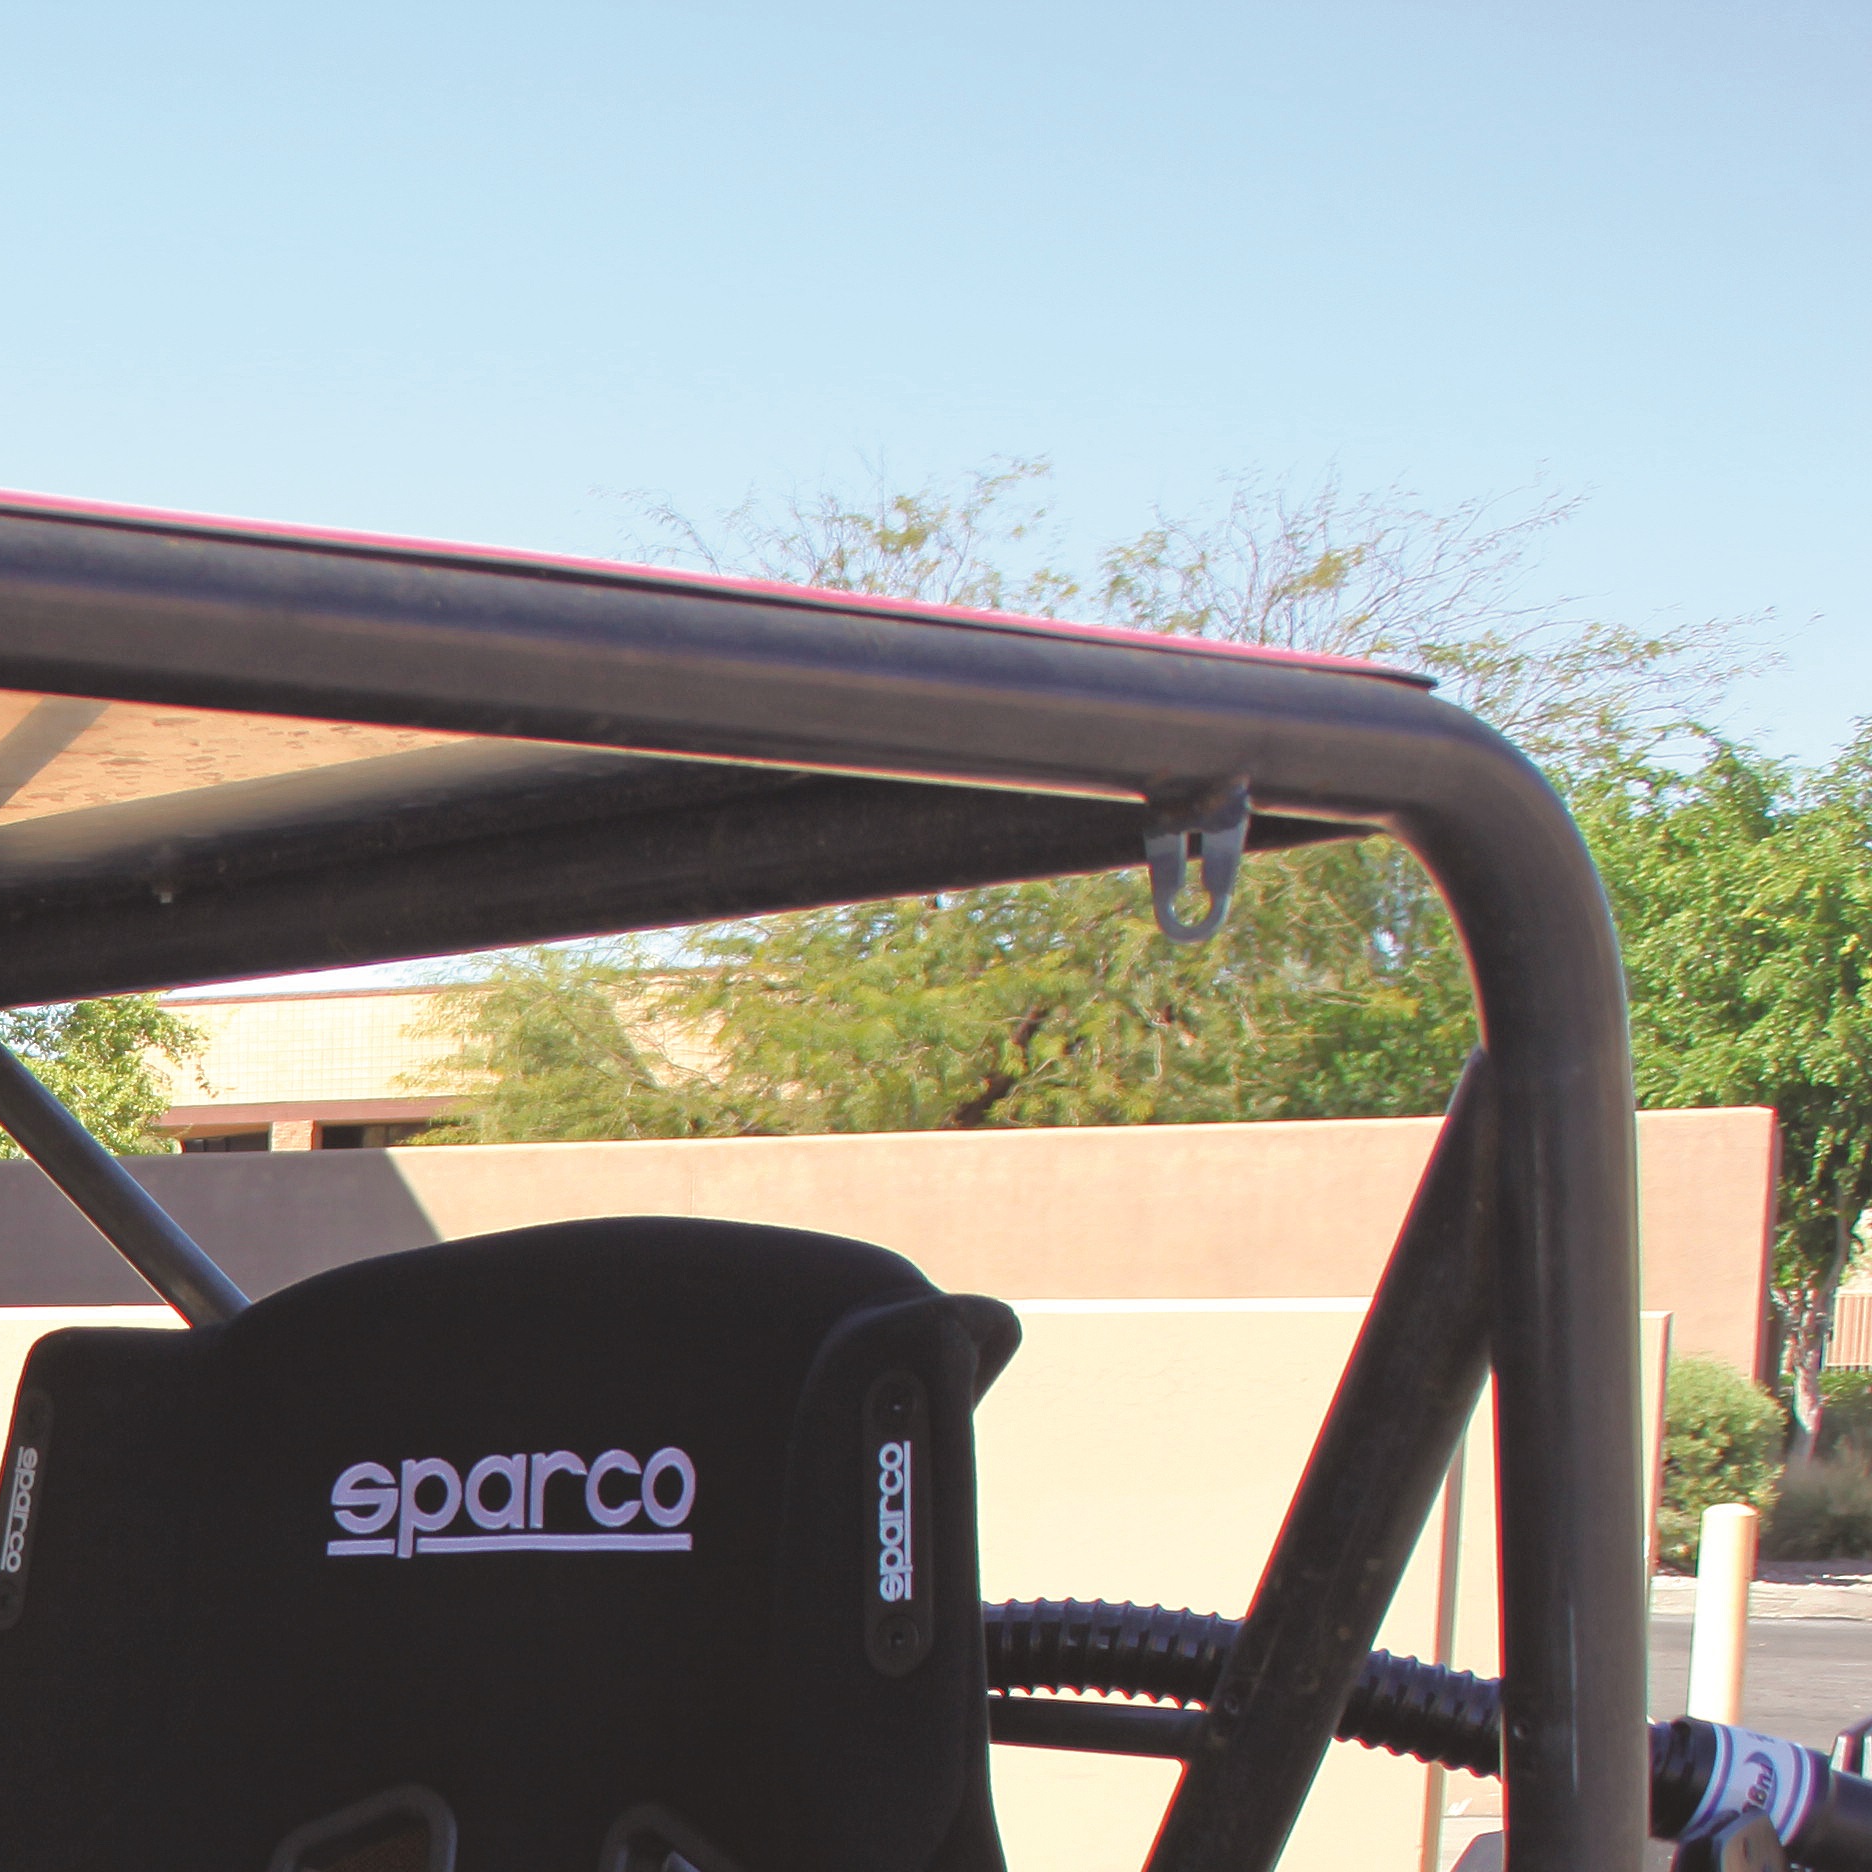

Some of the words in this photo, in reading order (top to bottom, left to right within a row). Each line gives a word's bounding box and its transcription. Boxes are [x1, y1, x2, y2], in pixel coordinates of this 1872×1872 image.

[0, 1446, 39, 1573] sparco
[327, 1446, 697, 1559] sparco
[878, 1440, 913, 1602] sparco
